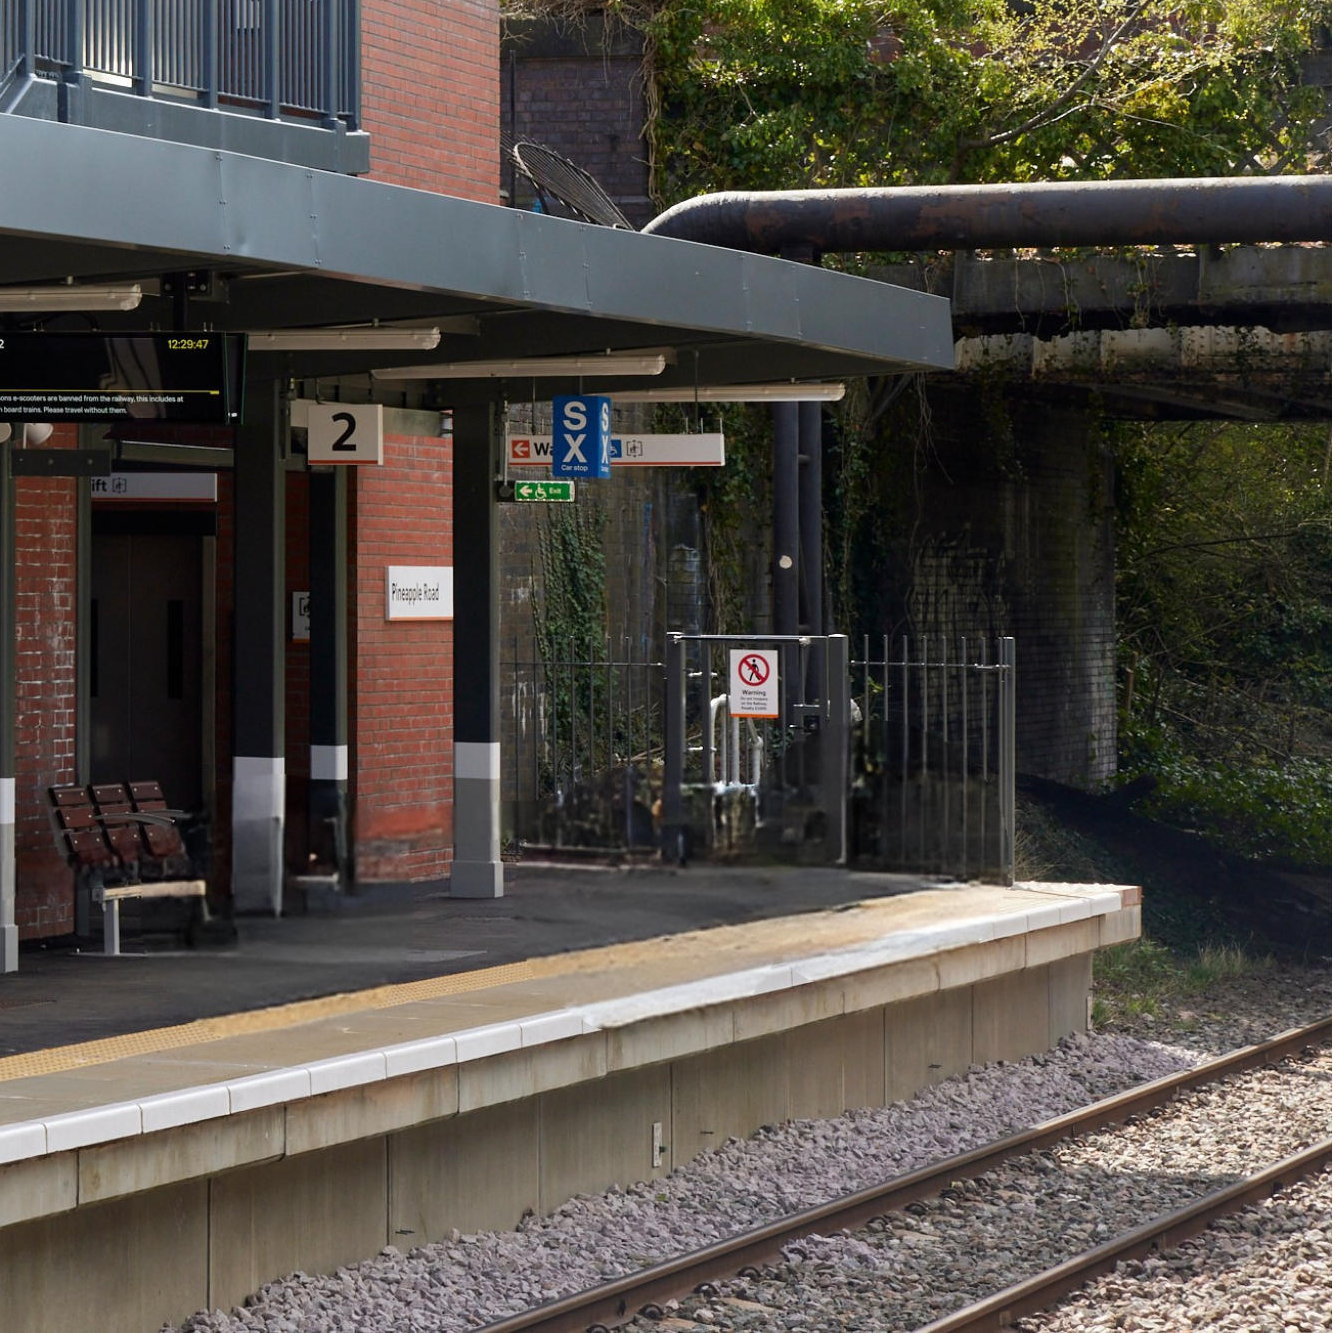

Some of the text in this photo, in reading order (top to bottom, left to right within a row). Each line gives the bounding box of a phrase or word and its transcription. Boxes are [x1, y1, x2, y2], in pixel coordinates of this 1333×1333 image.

[167, 339, 209, 349] 12:29:47
[111, 395, 136, 404] railway,
[136, 395, 148, 403] this
[149, 395, 176, 403] includes
[43, 406, 64, 414] Please
[65, 406, 83, 414] travel
[563, 401, 587, 431] S
[601, 402, 609, 432] S
[331, 412, 357, 452] 2
[534, 442, 553, 456] Wa
[562, 434, 587, 463] X
[601, 435, 609, 465] X
[91, 478, 108, 492] ift
[548, 487, 562, 495] Exit
[392, 583, 439, 605] Pineapple Road
